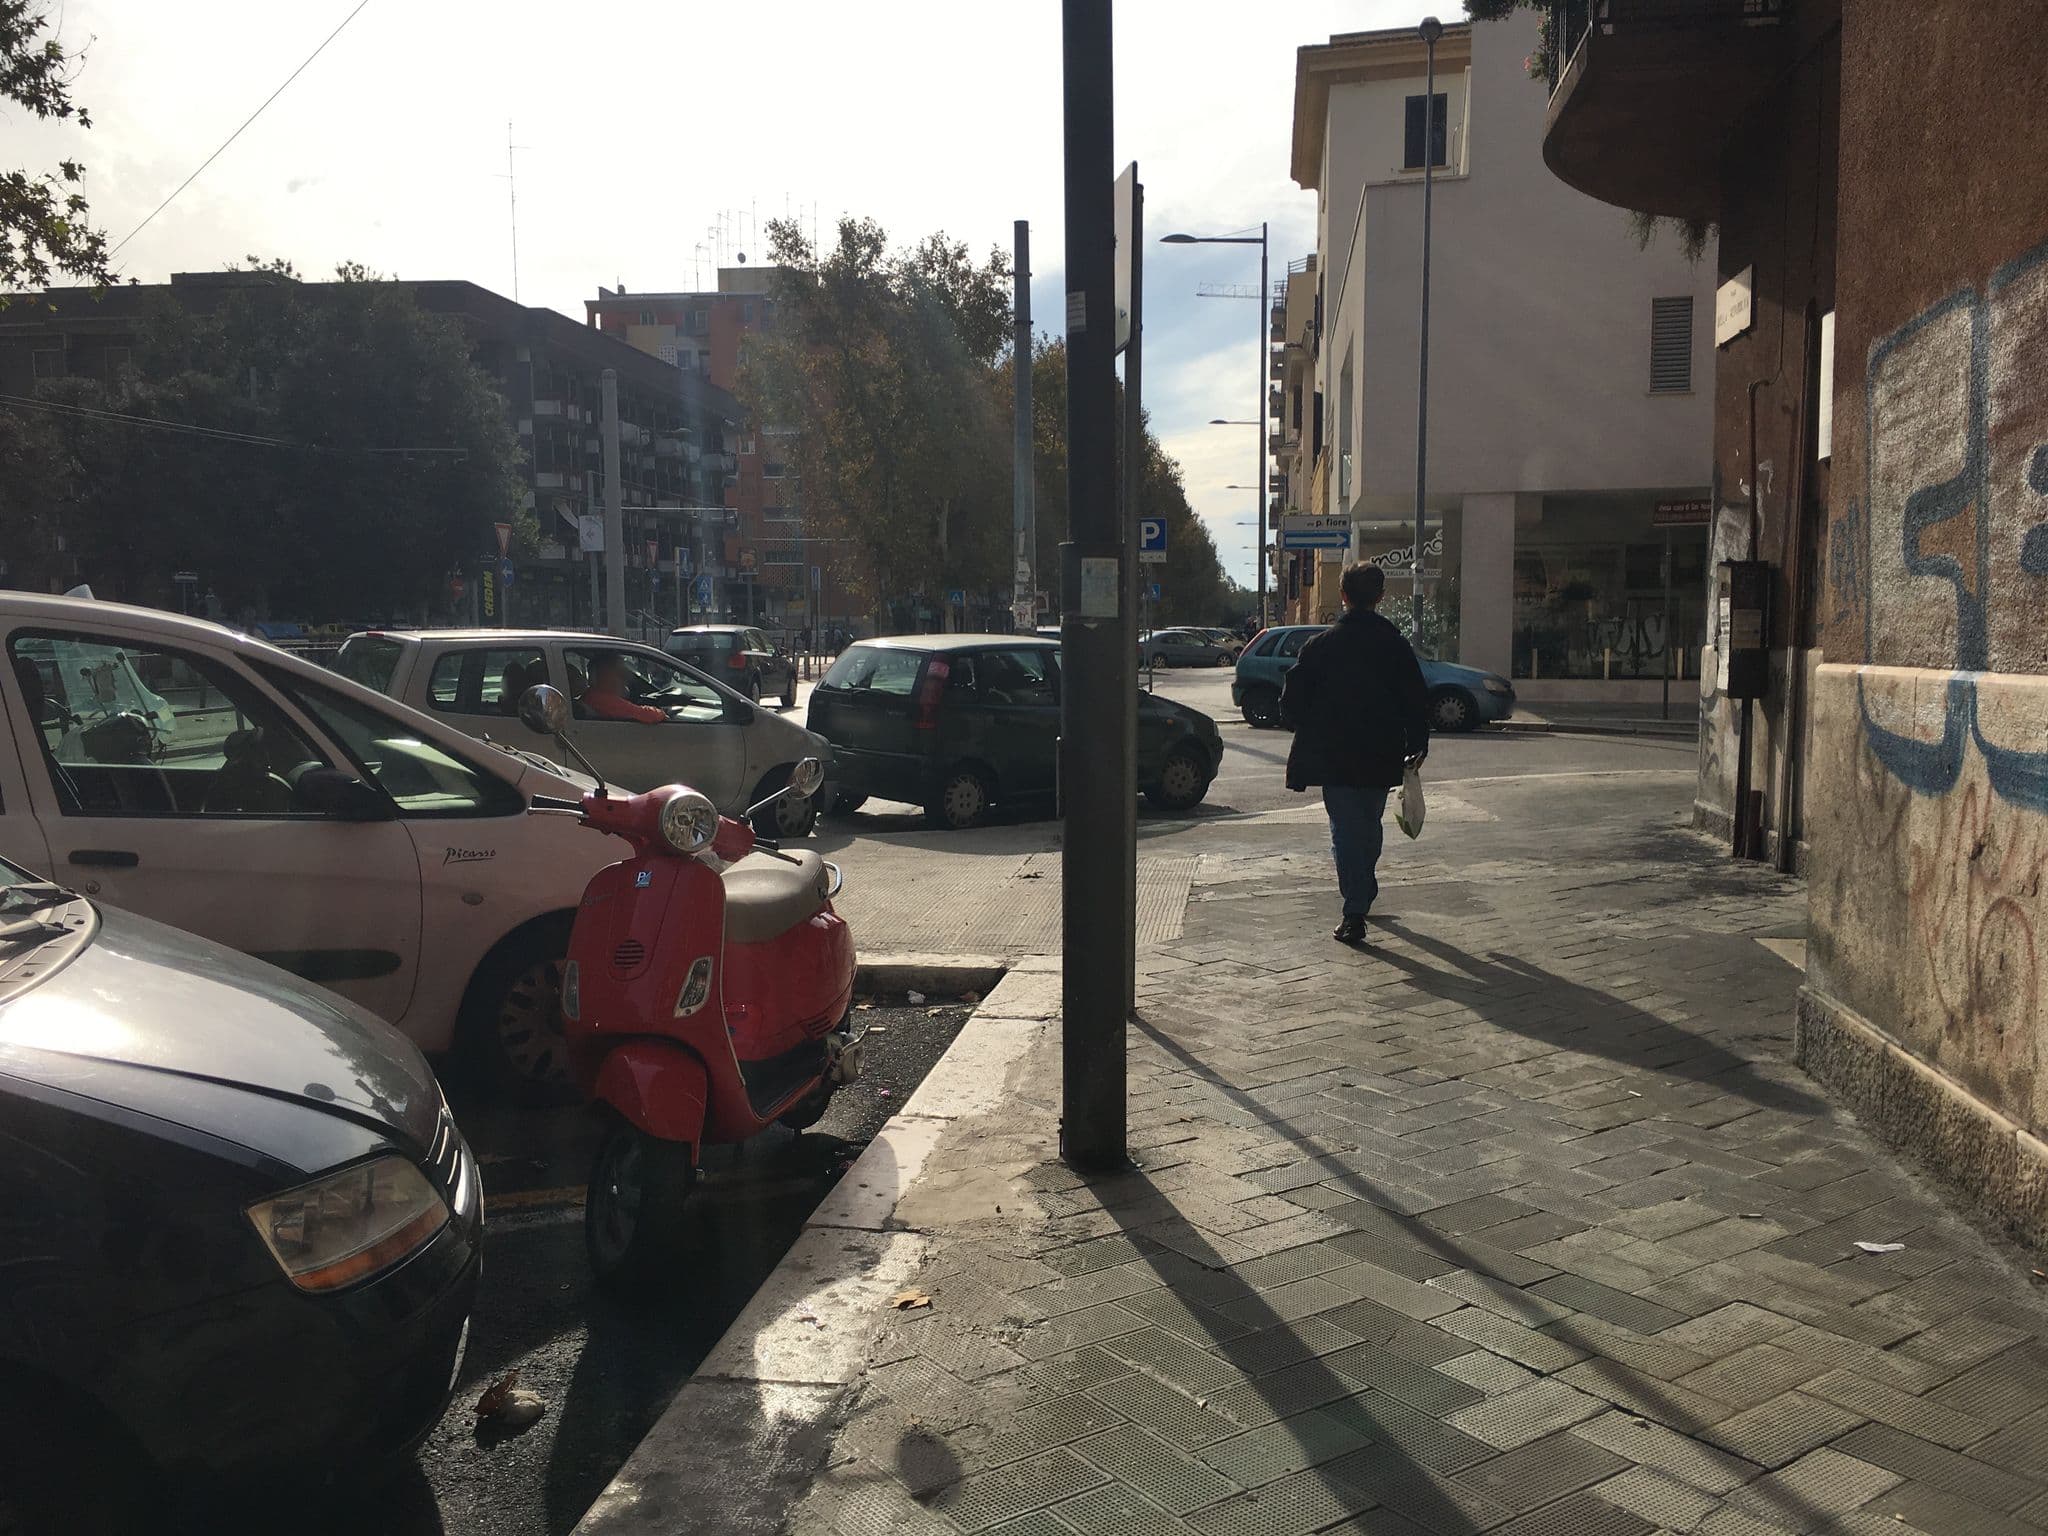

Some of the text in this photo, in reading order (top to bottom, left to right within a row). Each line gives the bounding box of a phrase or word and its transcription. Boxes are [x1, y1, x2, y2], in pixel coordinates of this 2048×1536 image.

[1326, 517, 1348, 527] fiore
[1140, 521, 1160, 549] P
[483, 569, 495, 616] CREDEM
[442, 847, 497, 868] Picasso
